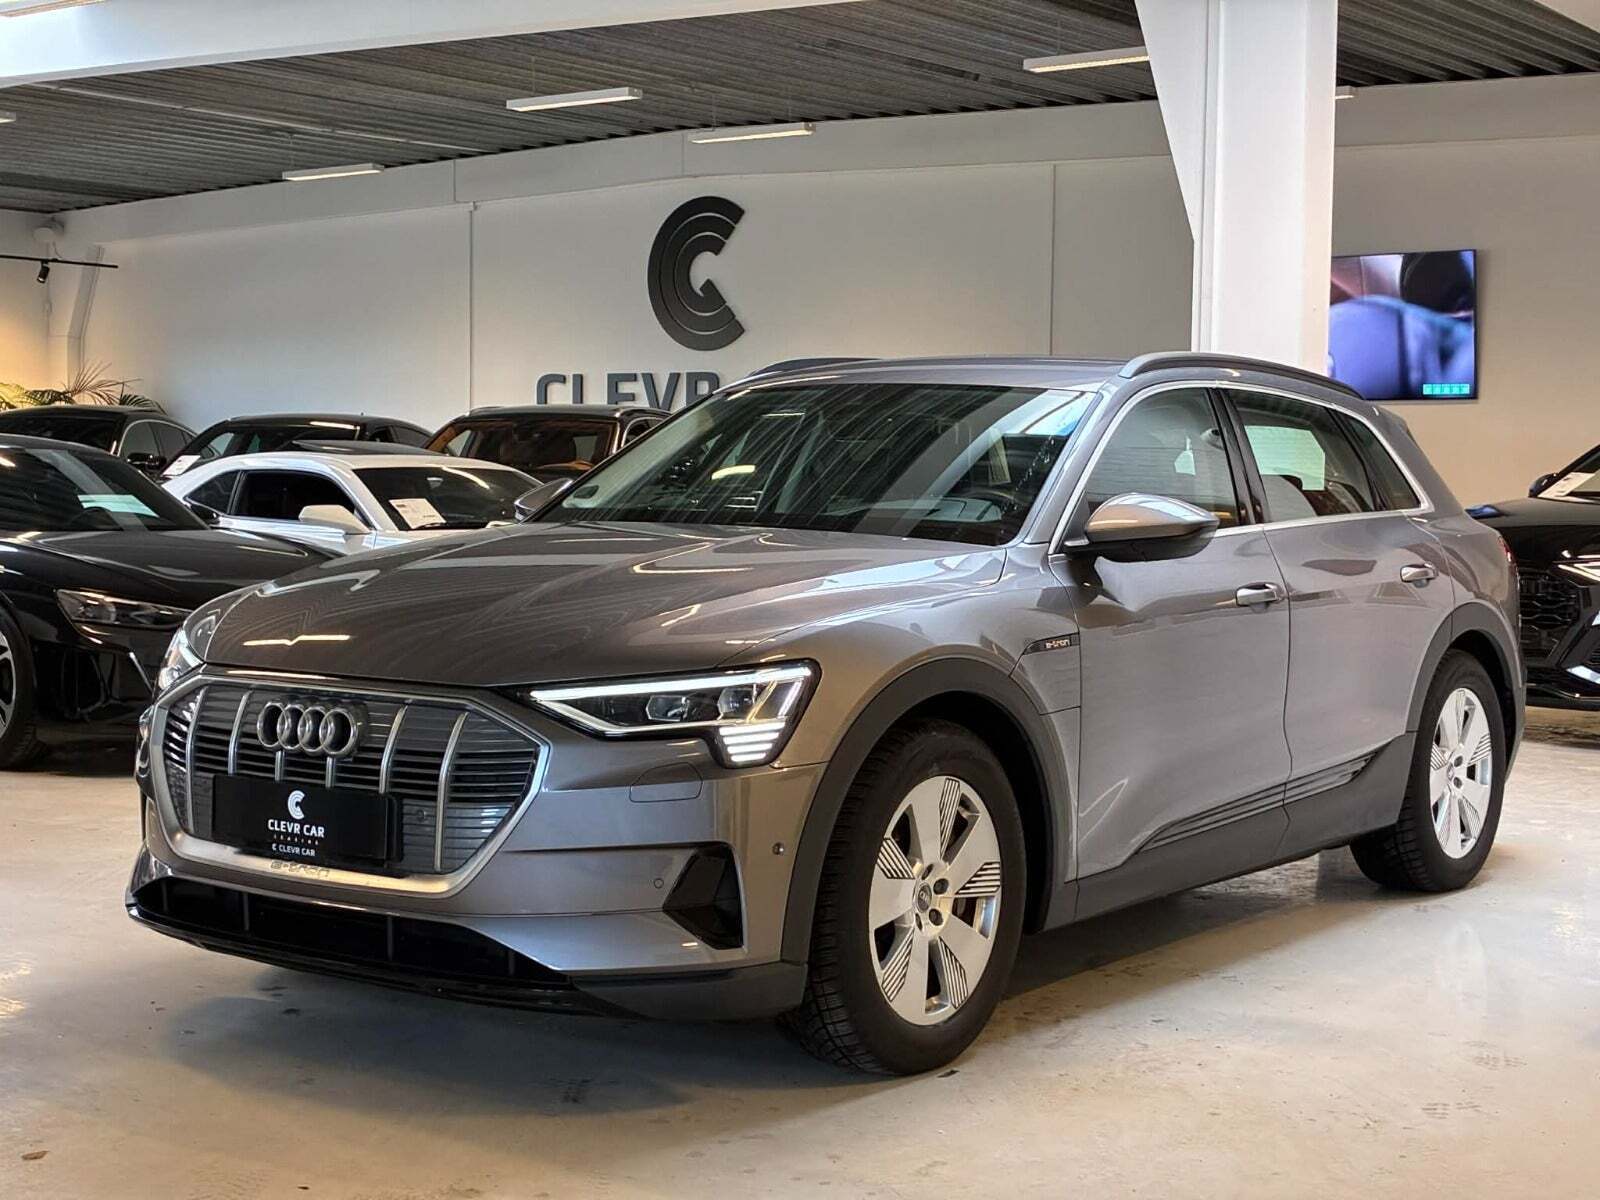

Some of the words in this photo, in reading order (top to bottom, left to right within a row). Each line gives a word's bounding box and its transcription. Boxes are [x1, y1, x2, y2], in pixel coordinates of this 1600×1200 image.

[268, 819, 300, 834] CLEVR
[303, 824, 325, 838] CAR
[301, 847, 316, 857] CAR
